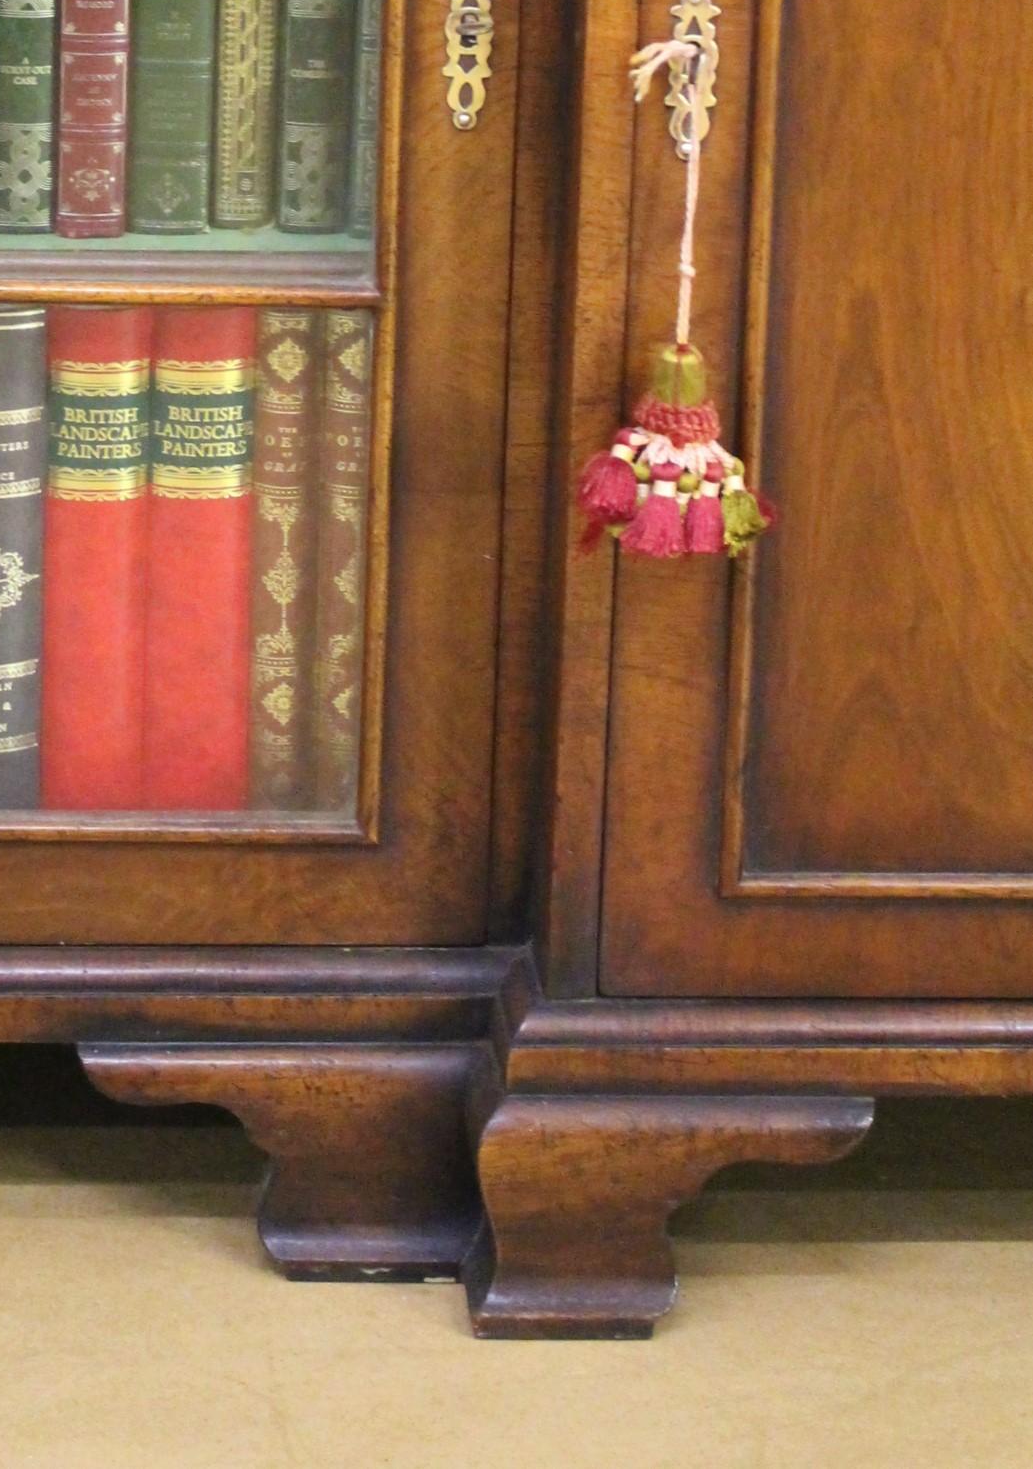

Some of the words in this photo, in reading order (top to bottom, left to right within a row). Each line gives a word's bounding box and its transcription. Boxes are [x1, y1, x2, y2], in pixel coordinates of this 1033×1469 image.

[64, 407, 139, 424] BRITISH
[168, 405, 243, 423] BRITISH
[51, 422, 149, 442] LANDSCAPE
[154, 420, 254, 440] LANDSCAPE
[57, 442, 142, 459] PAINTERS
[161, 440, 247, 457] PAINTERS
[2, 702, 13, 711] &
